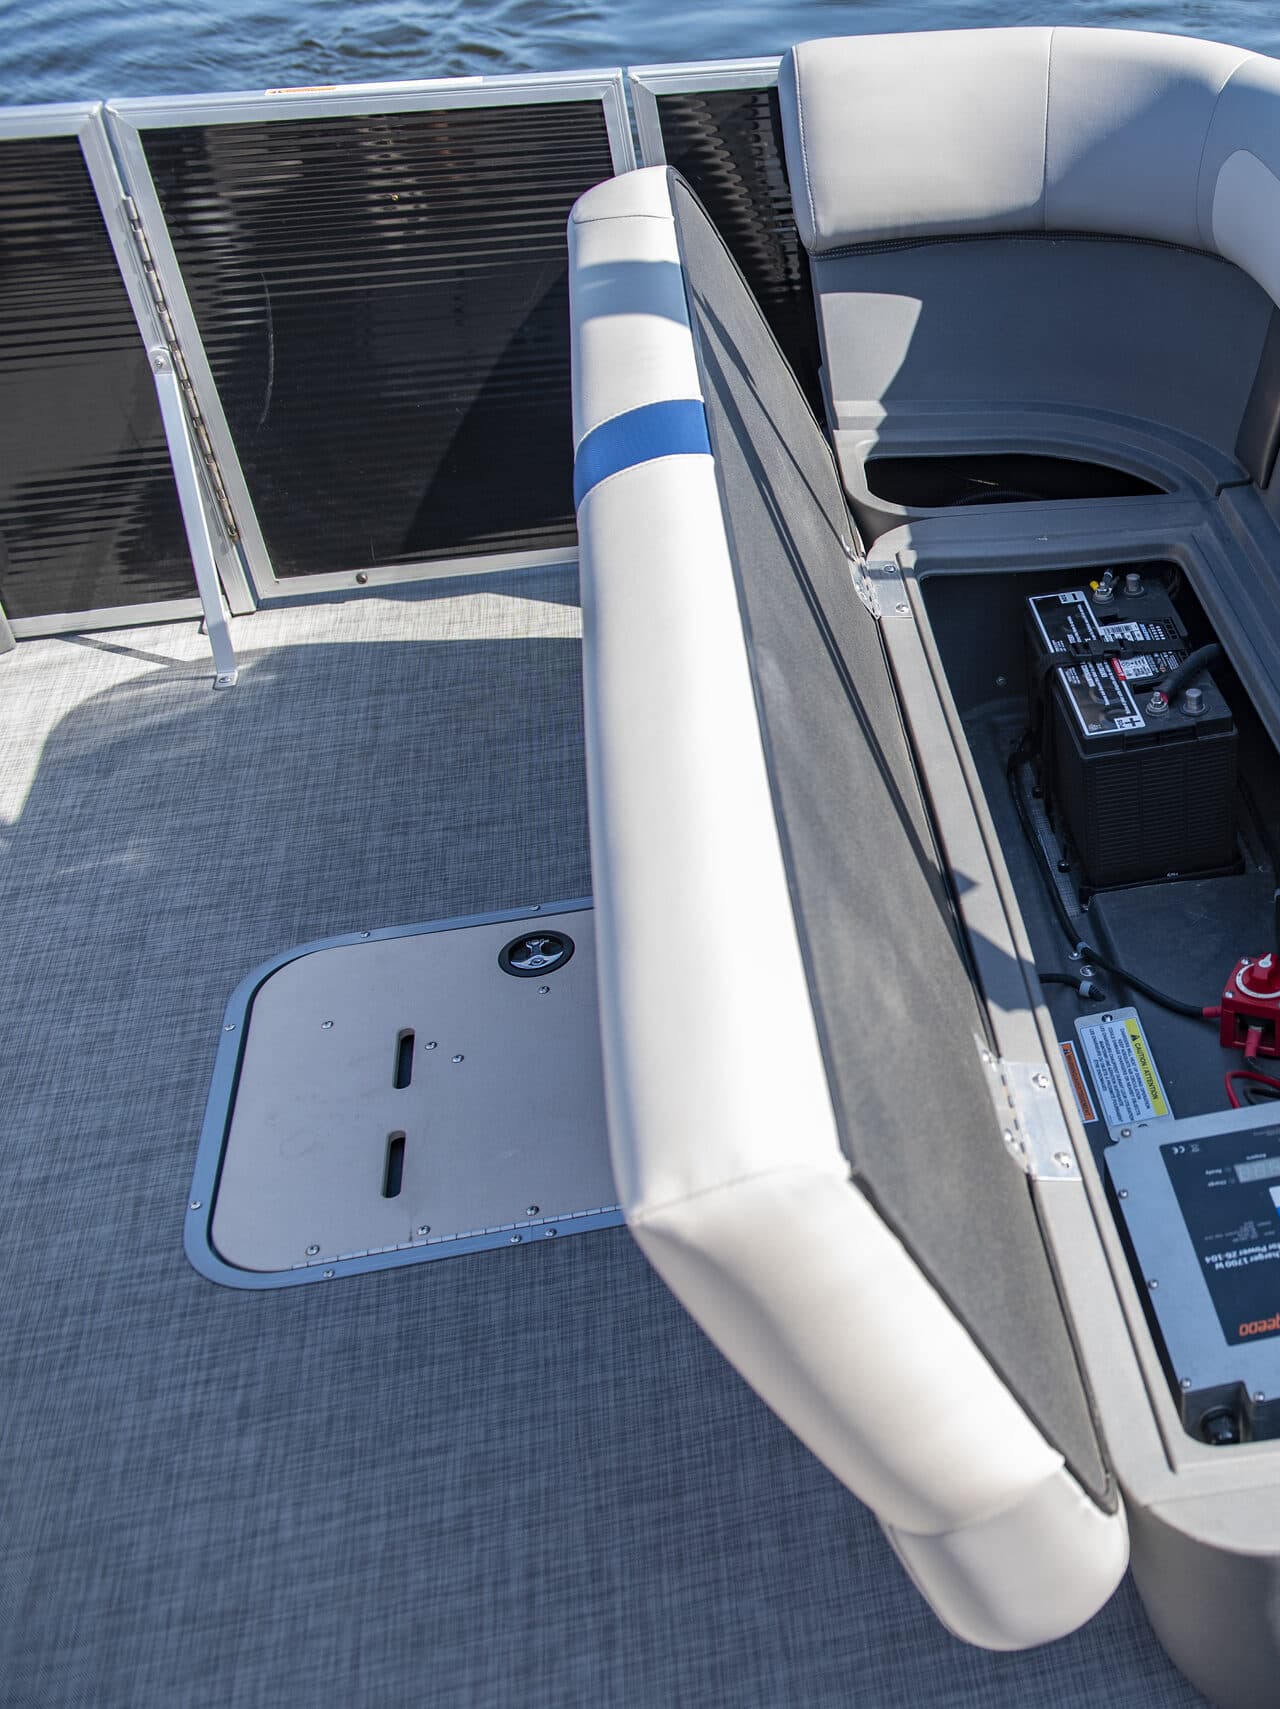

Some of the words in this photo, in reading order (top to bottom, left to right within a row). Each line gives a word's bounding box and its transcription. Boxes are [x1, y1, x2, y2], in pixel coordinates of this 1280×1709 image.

[1134, 1043, 1146, 1066] CAUTION
[1144, 1070, 1158, 1099] ATTENTION
[1239, 1245, 1267, 1256] Power
[1268, 1242, 1280, 1250] for
[1225, 1257, 1248, 1267] 1700
